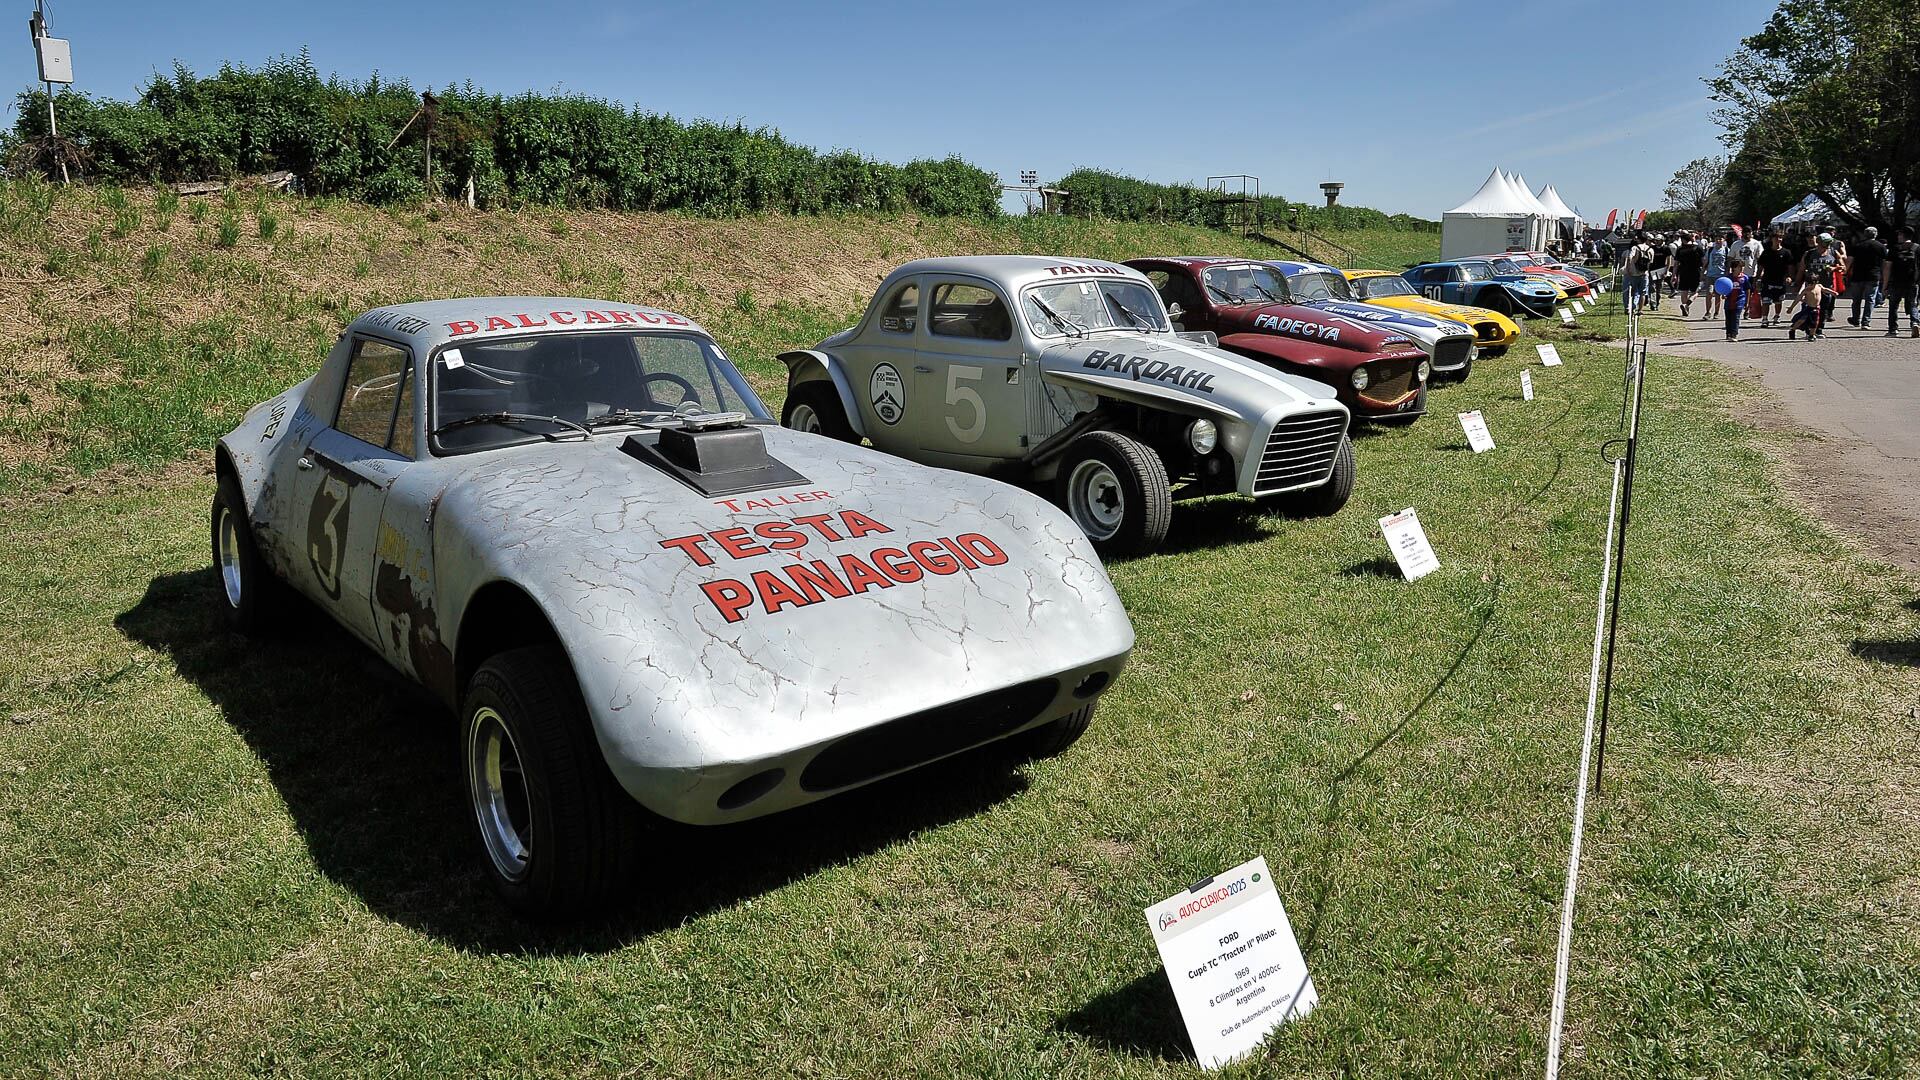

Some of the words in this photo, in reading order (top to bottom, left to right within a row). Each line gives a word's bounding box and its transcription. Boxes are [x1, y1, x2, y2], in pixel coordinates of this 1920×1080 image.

[1044, 265, 1125, 276] TANDIL
[1424, 285, 1442, 301] 50
[392, 316, 431, 335] PEZZI
[444, 310, 689, 337] BALCARCE
[1254, 313, 1341, 341] FADECYA
[1082, 350, 1216, 394] BARDAHL
[944, 364, 987, 443] 5
[714, 490, 835, 513] TALLER
[312, 474, 349, 593] 3
[658, 509, 895, 568] TESTA
[786, 550, 805, 561] Y
[698, 532, 1010, 624] PANAGGIO
[1218, 931, 1239, 947] FORD
[1188, 963, 1207, 980] Cupé
[1207, 958, 1219, 969] TC
[1218, 944, 1247, 962] "Tractor
[1255, 928, 1278, 944] Piloto:
[1209, 999, 1215, 1008] 8
[1215, 984, 1244, 1005] Cilindros
[1243, 980, 1252, 989] en
[1252, 975, 1257, 983] V
[1258, 963, 1281, 979] 4000cc
[1234, 966, 1250, 980] 1969
[1236, 986, 1266, 1007] Argentina
[1221, 1026, 1234, 1037] Club
[1234, 1021, 1241, 1030] de
